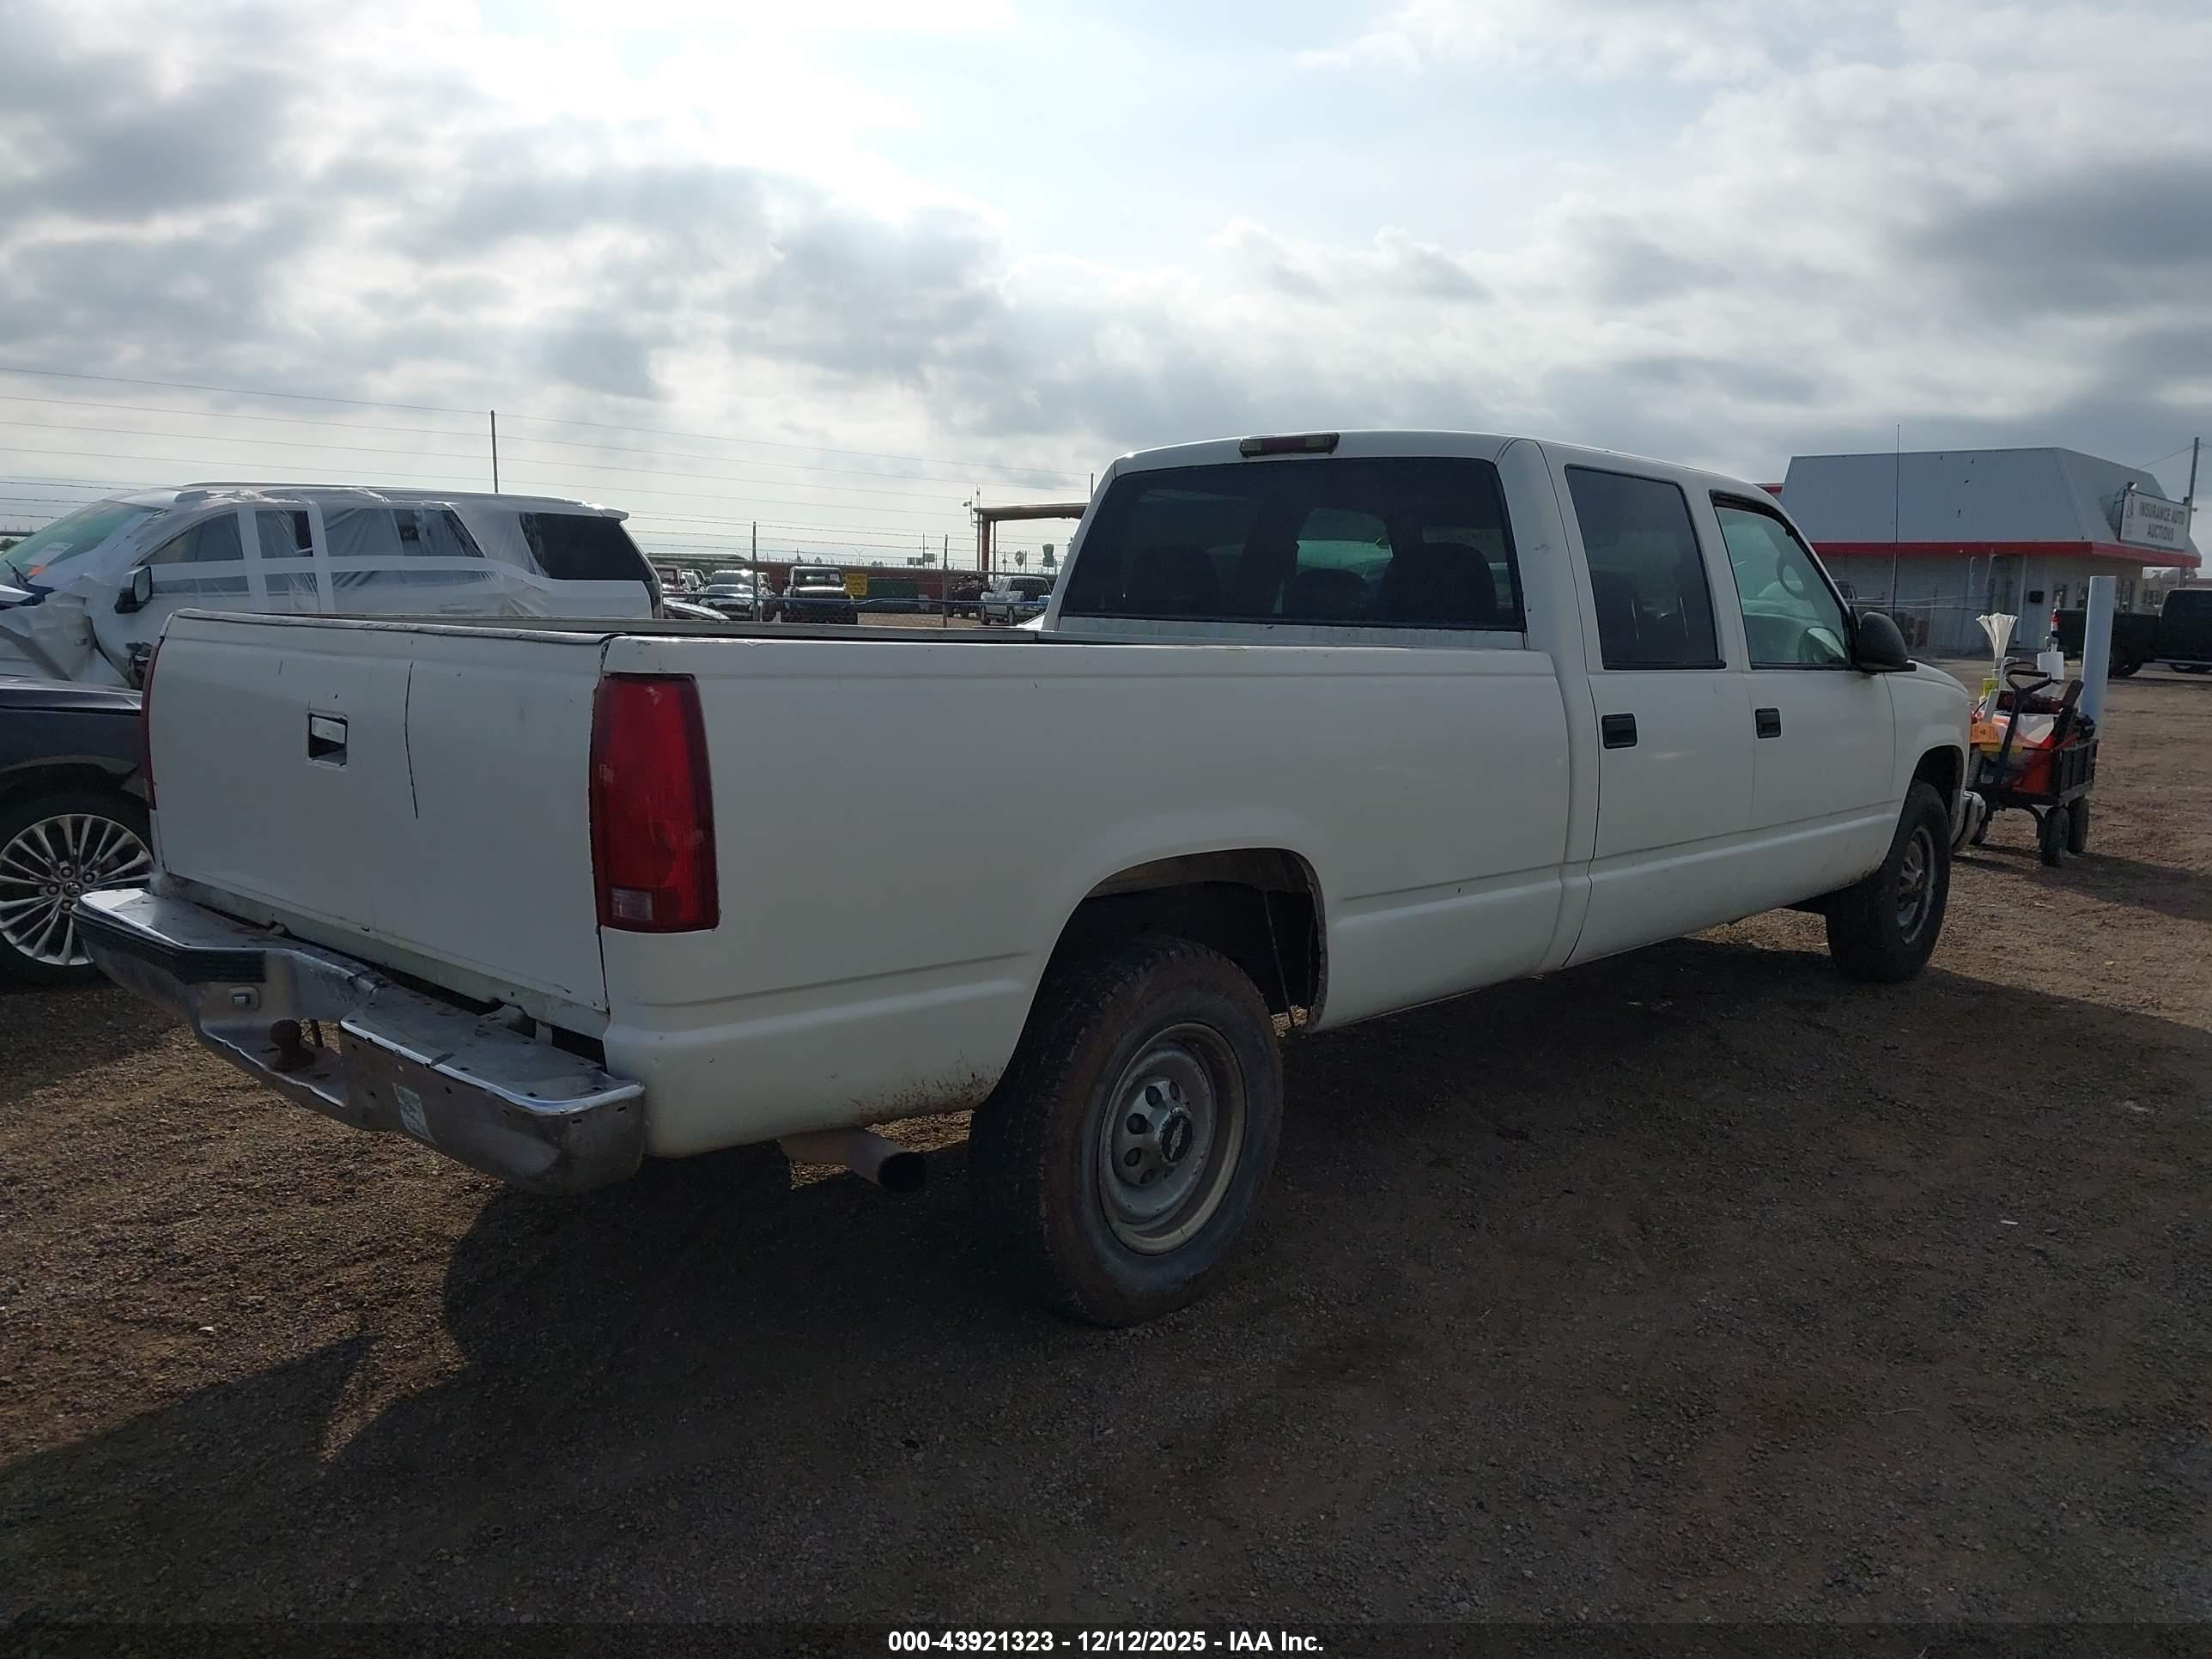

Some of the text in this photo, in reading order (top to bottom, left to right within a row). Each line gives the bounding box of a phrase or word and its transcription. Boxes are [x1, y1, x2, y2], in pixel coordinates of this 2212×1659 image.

[2139, 501, 2171, 522] INSURANCE
[2172, 509, 2185, 525] AUTO
[2148, 523, 2174, 541] AUCTIONS
